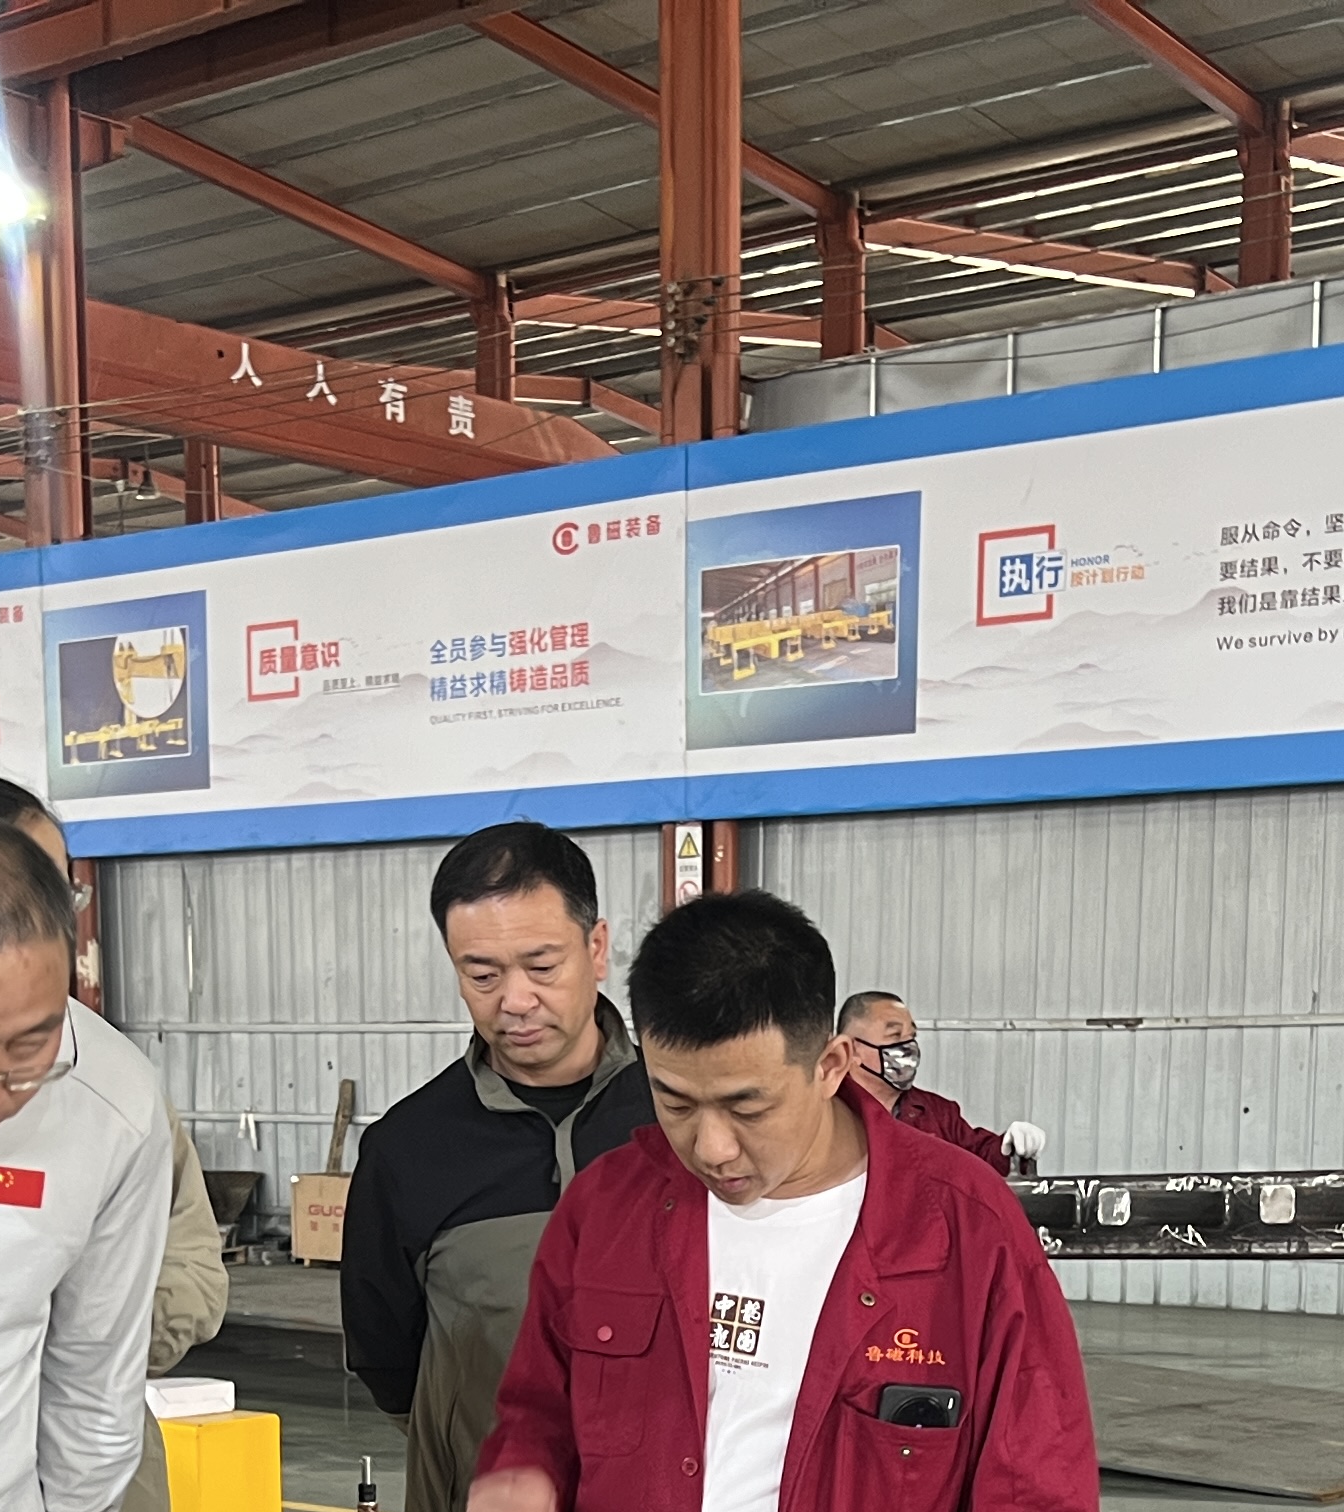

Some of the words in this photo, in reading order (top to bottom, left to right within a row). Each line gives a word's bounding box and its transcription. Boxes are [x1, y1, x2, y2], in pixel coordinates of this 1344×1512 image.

[1002, 555, 1064, 594] 执行
[1070, 554, 1110, 568] HONOR
[430, 621, 590, 665] 全员参与强化管理
[1216, 635, 1244, 651] We
[1248, 630, 1314, 648] survive
[1318, 627, 1339, 644] by
[259, 640, 341, 676] 质量意识
[430, 660, 591, 703] 精益求精铸造品质
[430, 713, 467, 725] QUALITY
[540, 704, 560, 715] FOR
